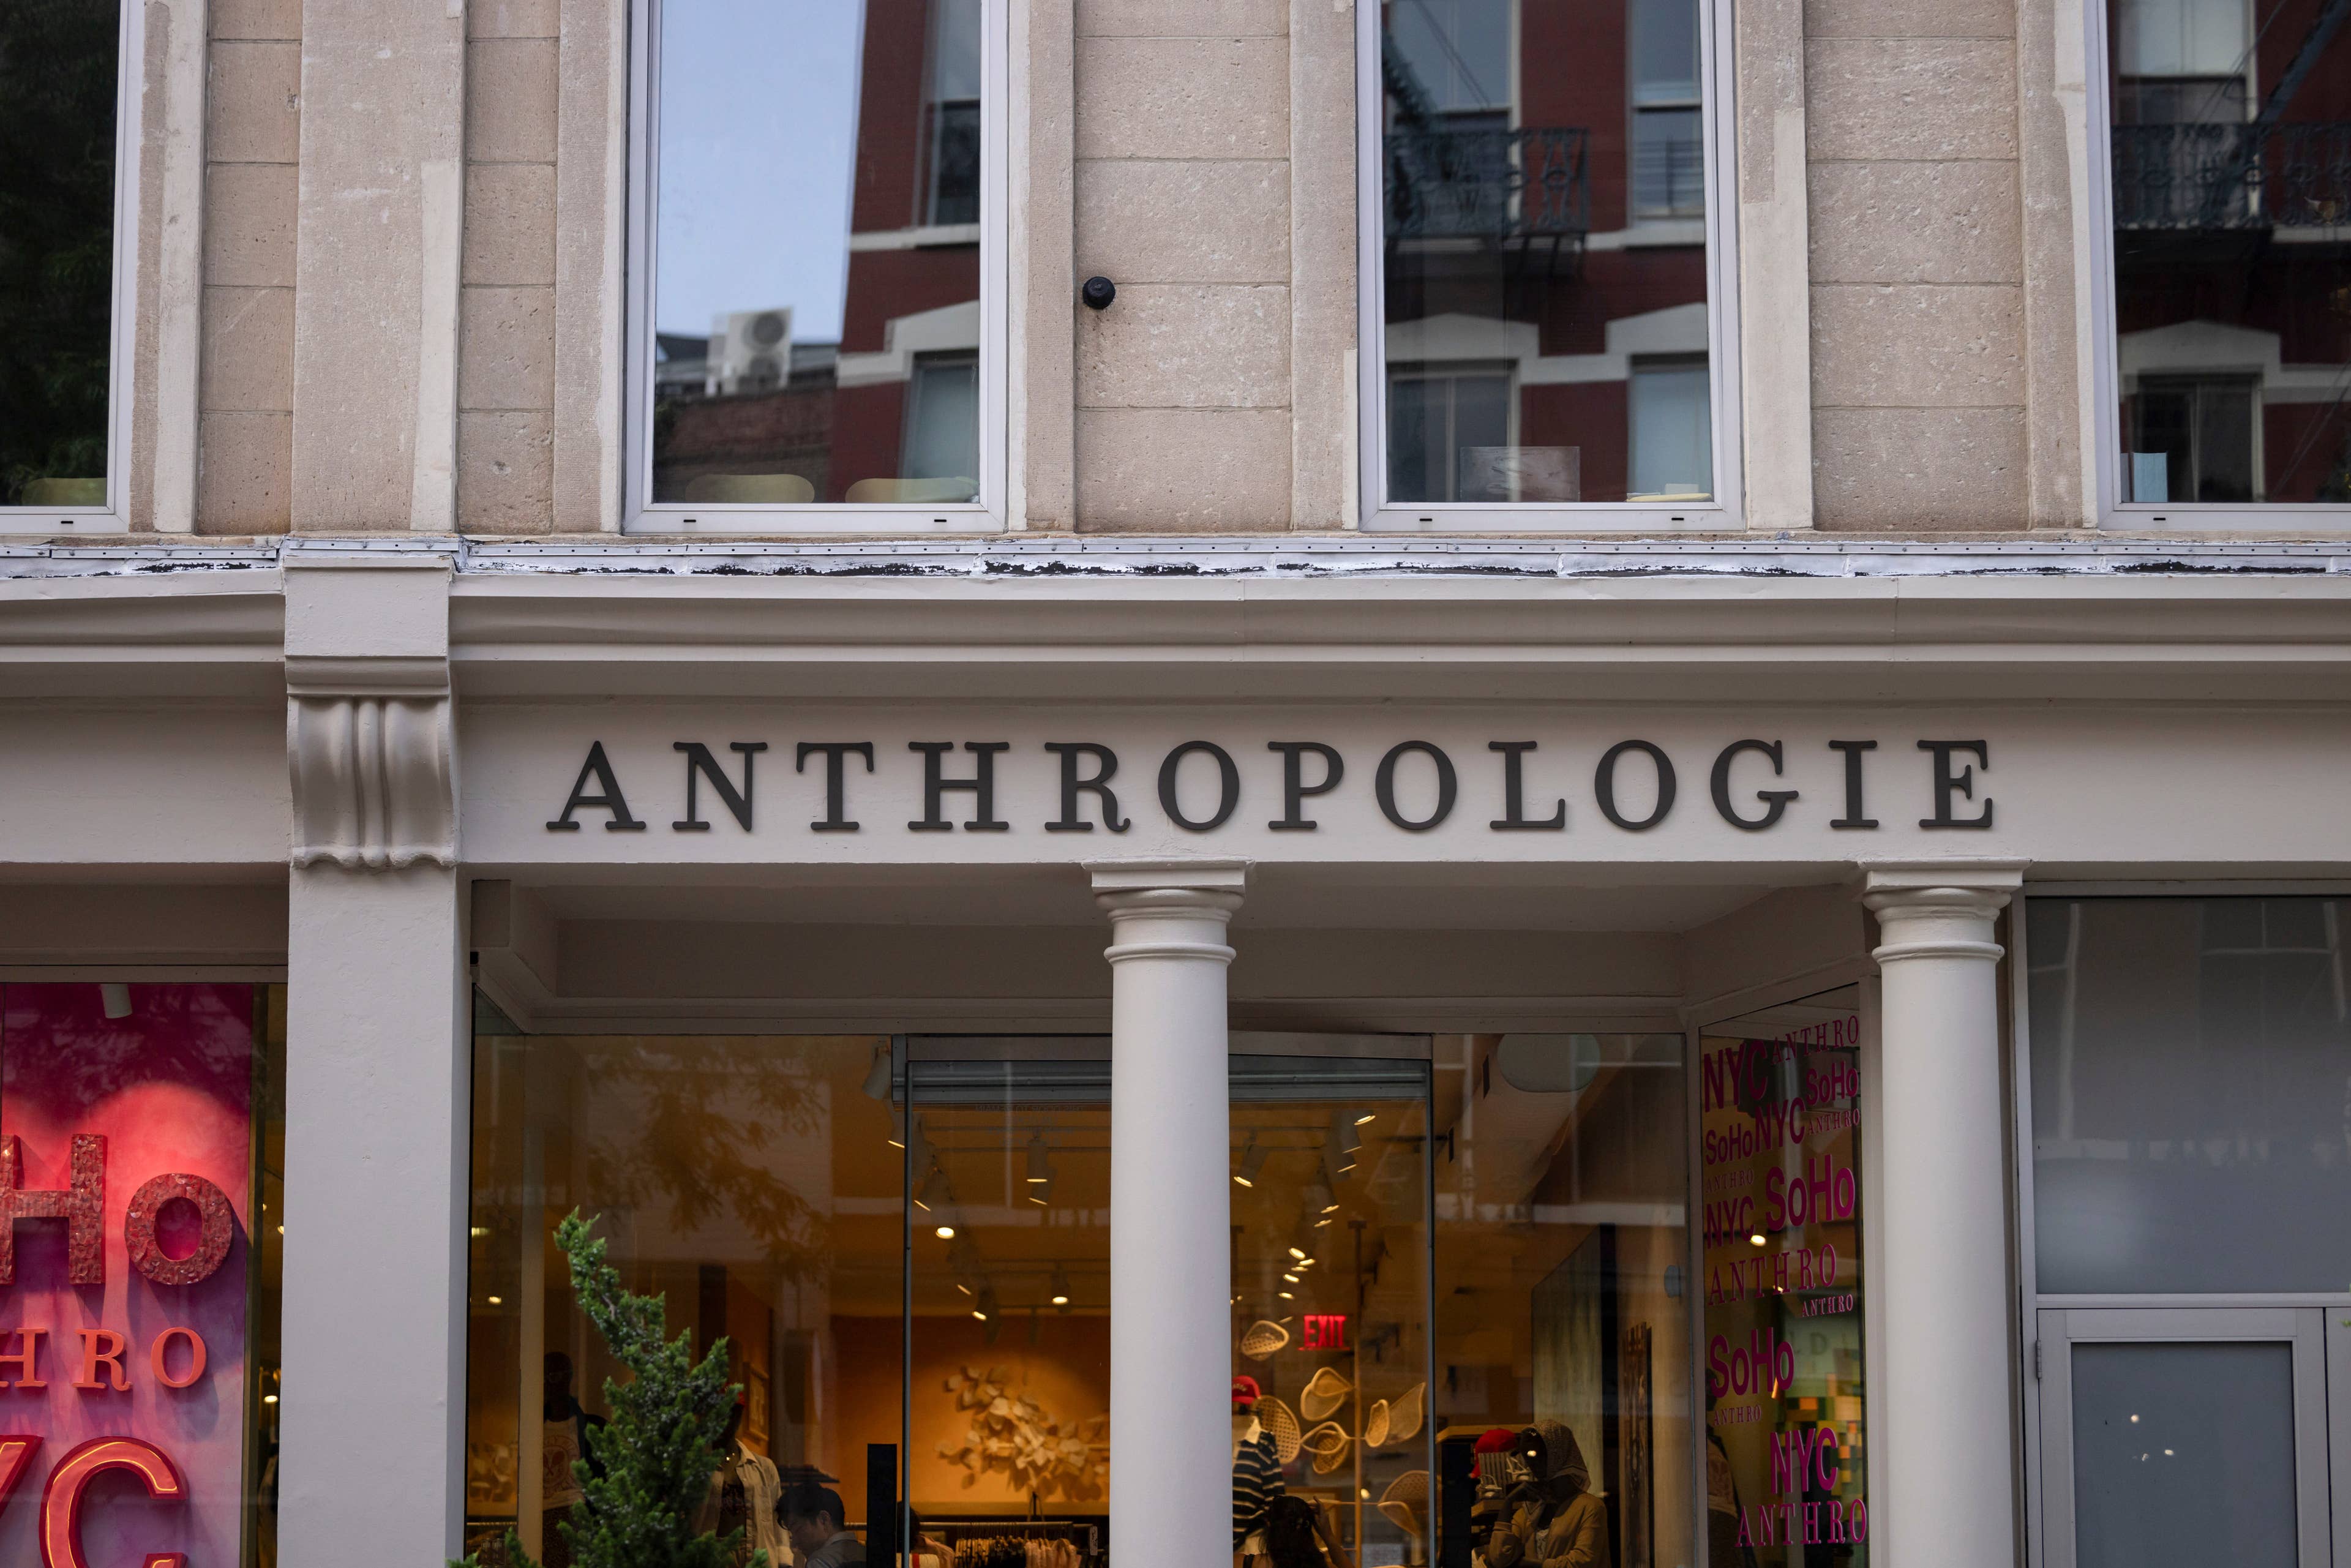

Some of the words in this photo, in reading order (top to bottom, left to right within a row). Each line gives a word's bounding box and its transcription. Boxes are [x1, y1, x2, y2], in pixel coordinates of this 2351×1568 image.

[546, 739, 1993, 831] ANTHROPOLOGIE
[1770, 1015, 1859, 1065] ANTHRO
[1703, 1040, 1768, 1112] NYC
[1805, 1060, 1858, 1106] SoHo
[1705, 1123, 1753, 1165] SoHo
[1755, 1097, 1805, 1153] NYC
[1807, 1108, 1860, 1136] ANTHRO
[1705, 1169, 1753, 1193] ANTHRO
[1765, 1153, 1855, 1232] SoHo
[1706, 1196, 1755, 1249] NYC
[1708, 1244, 1837, 1306] ANTHRO
[1303, 1315, 1347, 1347] EXIT
[1802, 1294, 1853, 1318] ANTHRO
[1710, 1327, 1794, 1398] SoHo
[1714, 1405, 1761, 1426] ANTHRO
[1771, 1427, 1838, 1494] NYC
[1735, 1499, 1867, 1547] ANTHRO
